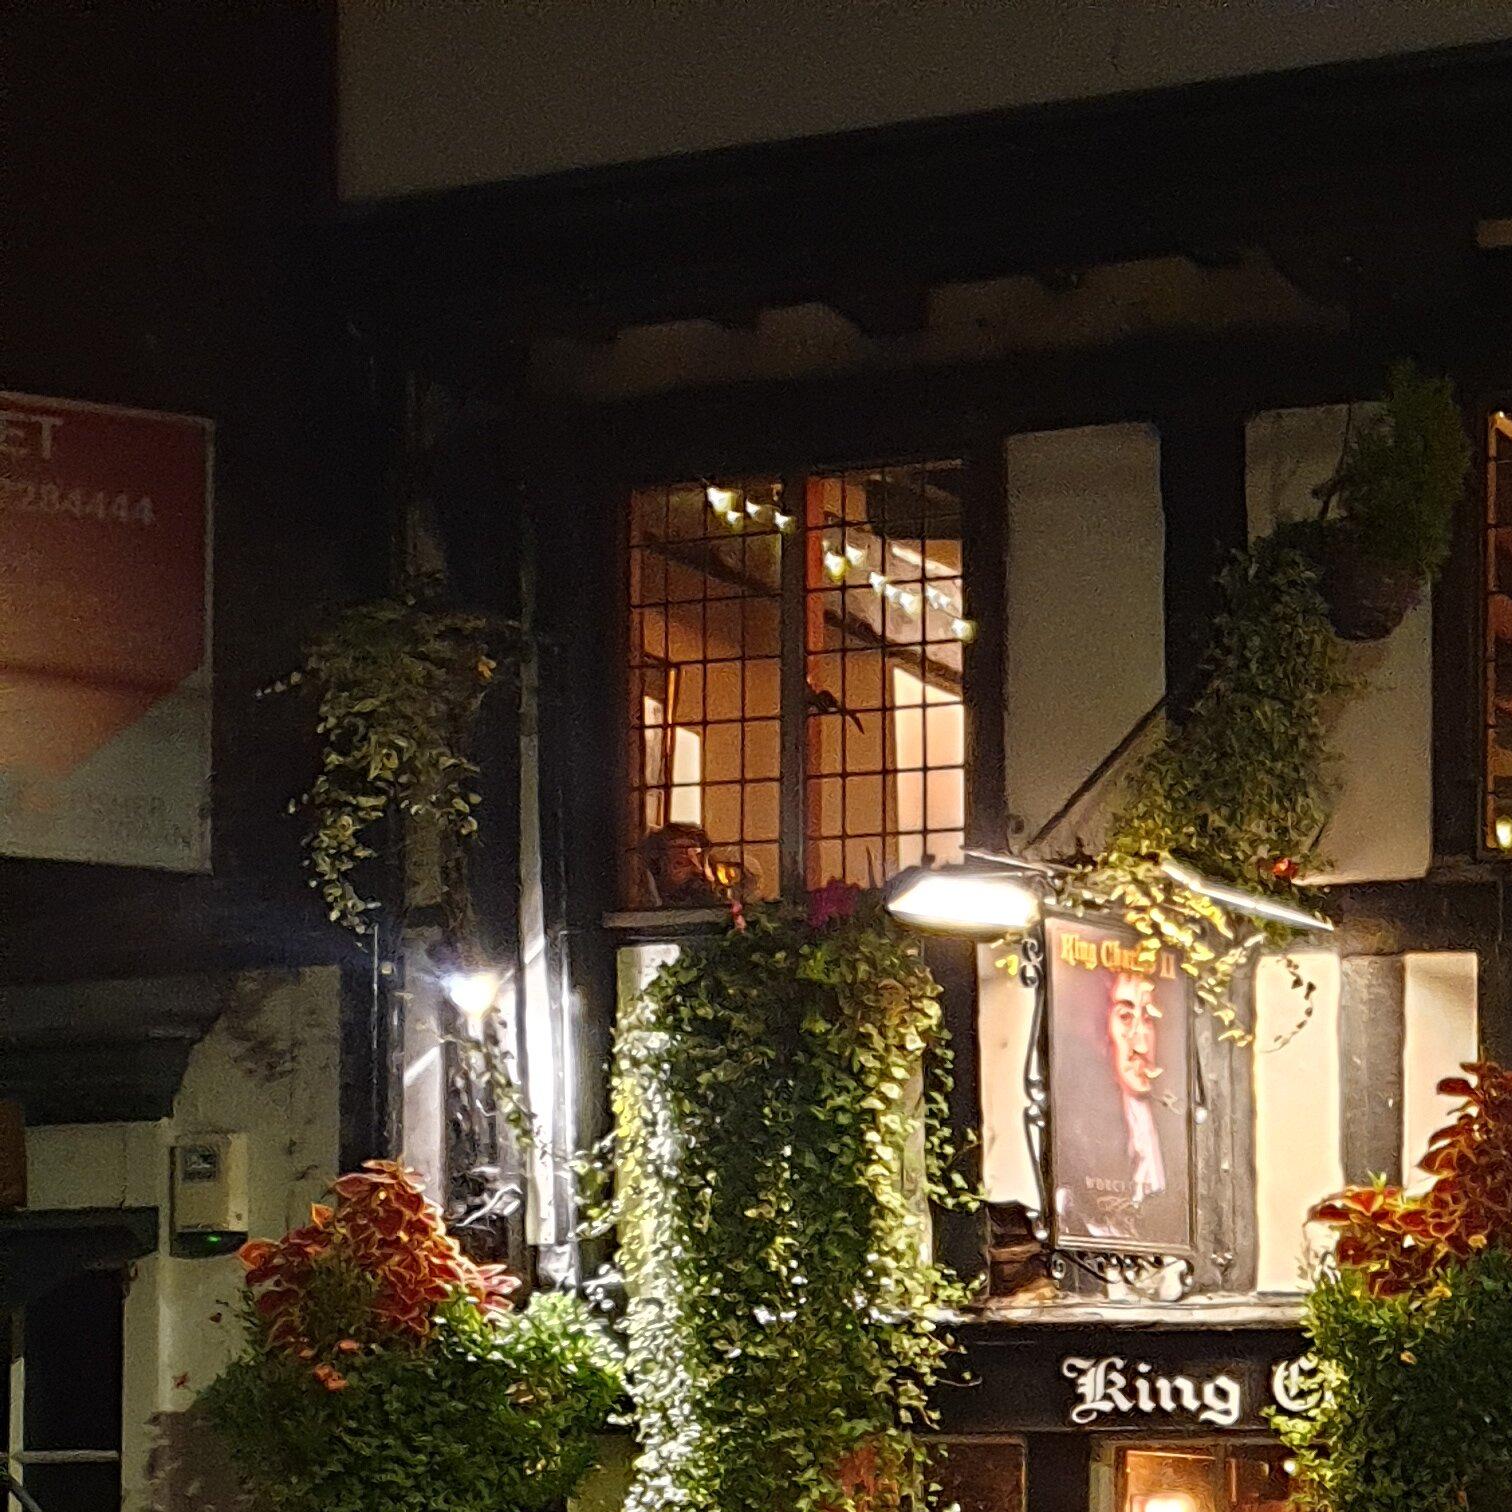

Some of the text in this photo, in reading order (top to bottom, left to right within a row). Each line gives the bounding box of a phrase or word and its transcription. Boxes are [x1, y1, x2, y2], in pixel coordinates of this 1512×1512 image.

[1060, 932, 1097, 970] King
[1101, 940, 1156, 974] Char
[1062, 1356, 1241, 1426] King
